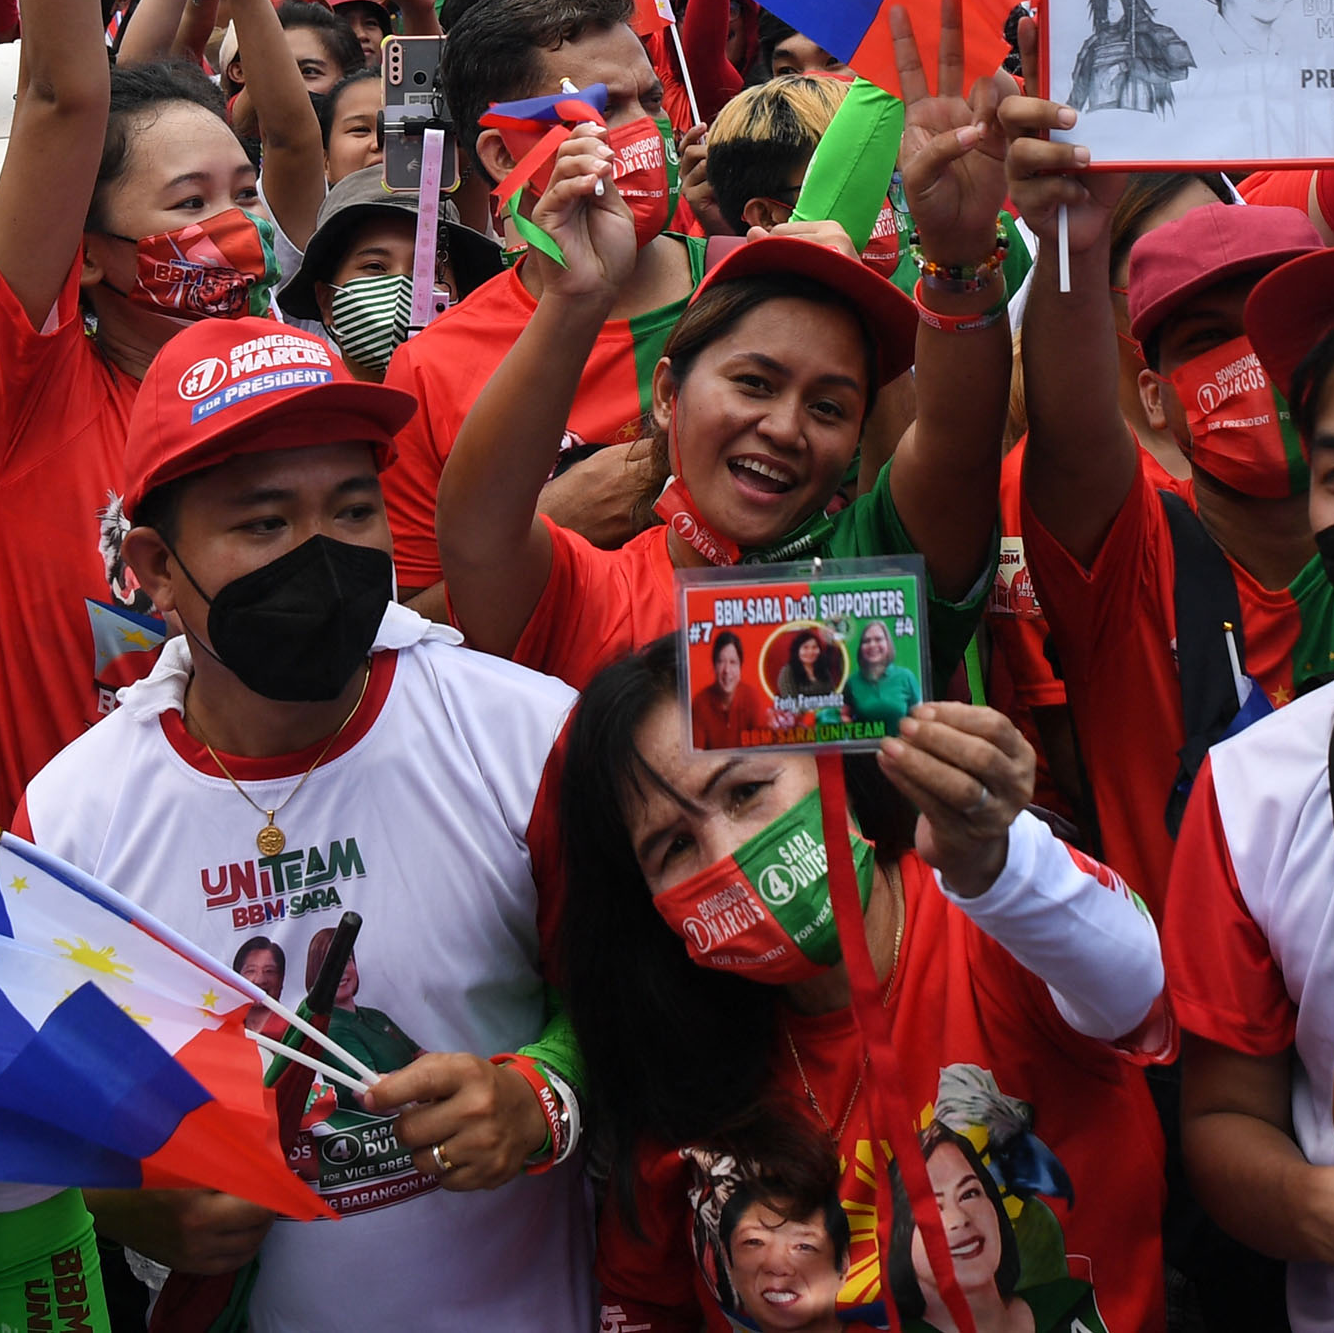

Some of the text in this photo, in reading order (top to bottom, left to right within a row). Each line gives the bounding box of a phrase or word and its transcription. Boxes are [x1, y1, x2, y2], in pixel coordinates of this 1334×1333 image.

[870, 219, 896, 239] ARCOS
[155, 263, 205, 286] BBM
[229, 334, 326, 361] BONGBONG
[230, 347, 332, 378] MARCOS
[1215, 352, 1261, 385] BONGBONG
[185, 358, 218, 395] #7
[1221, 367, 1266, 401] MARCOS
[198, 397, 222, 415] FOR
[1202, 388, 1215, 409] 7
[1222, 414, 1270, 428] PRESIDENT
[1279, 412, 1291, 421] FO
[679, 517, 693, 534] 7
[999, 553, 1020, 565] BBM
[714, 590, 905, 627] BBM-SARA Du30 SUPPORTERS
[688, 621, 714, 644] #7
[894, 616, 915, 638] #4
[777, 726, 816, 743] SARA
[819, 721, 886, 742] UNITEAM
[779, 829, 817, 865] SARA
[767, 869, 791, 898] 4
[697, 881, 749, 921] BONGBONG
[707, 898, 765, 944] MARCOS
[687, 921, 704, 948] 7
[794, 925, 814, 944] FOR
[329, 1138, 352, 1160] 4
[323, 1172, 341, 1182] FOR
[344, 1163, 376, 1180] VICE
[341, 1179, 419, 1209] BABANGON
